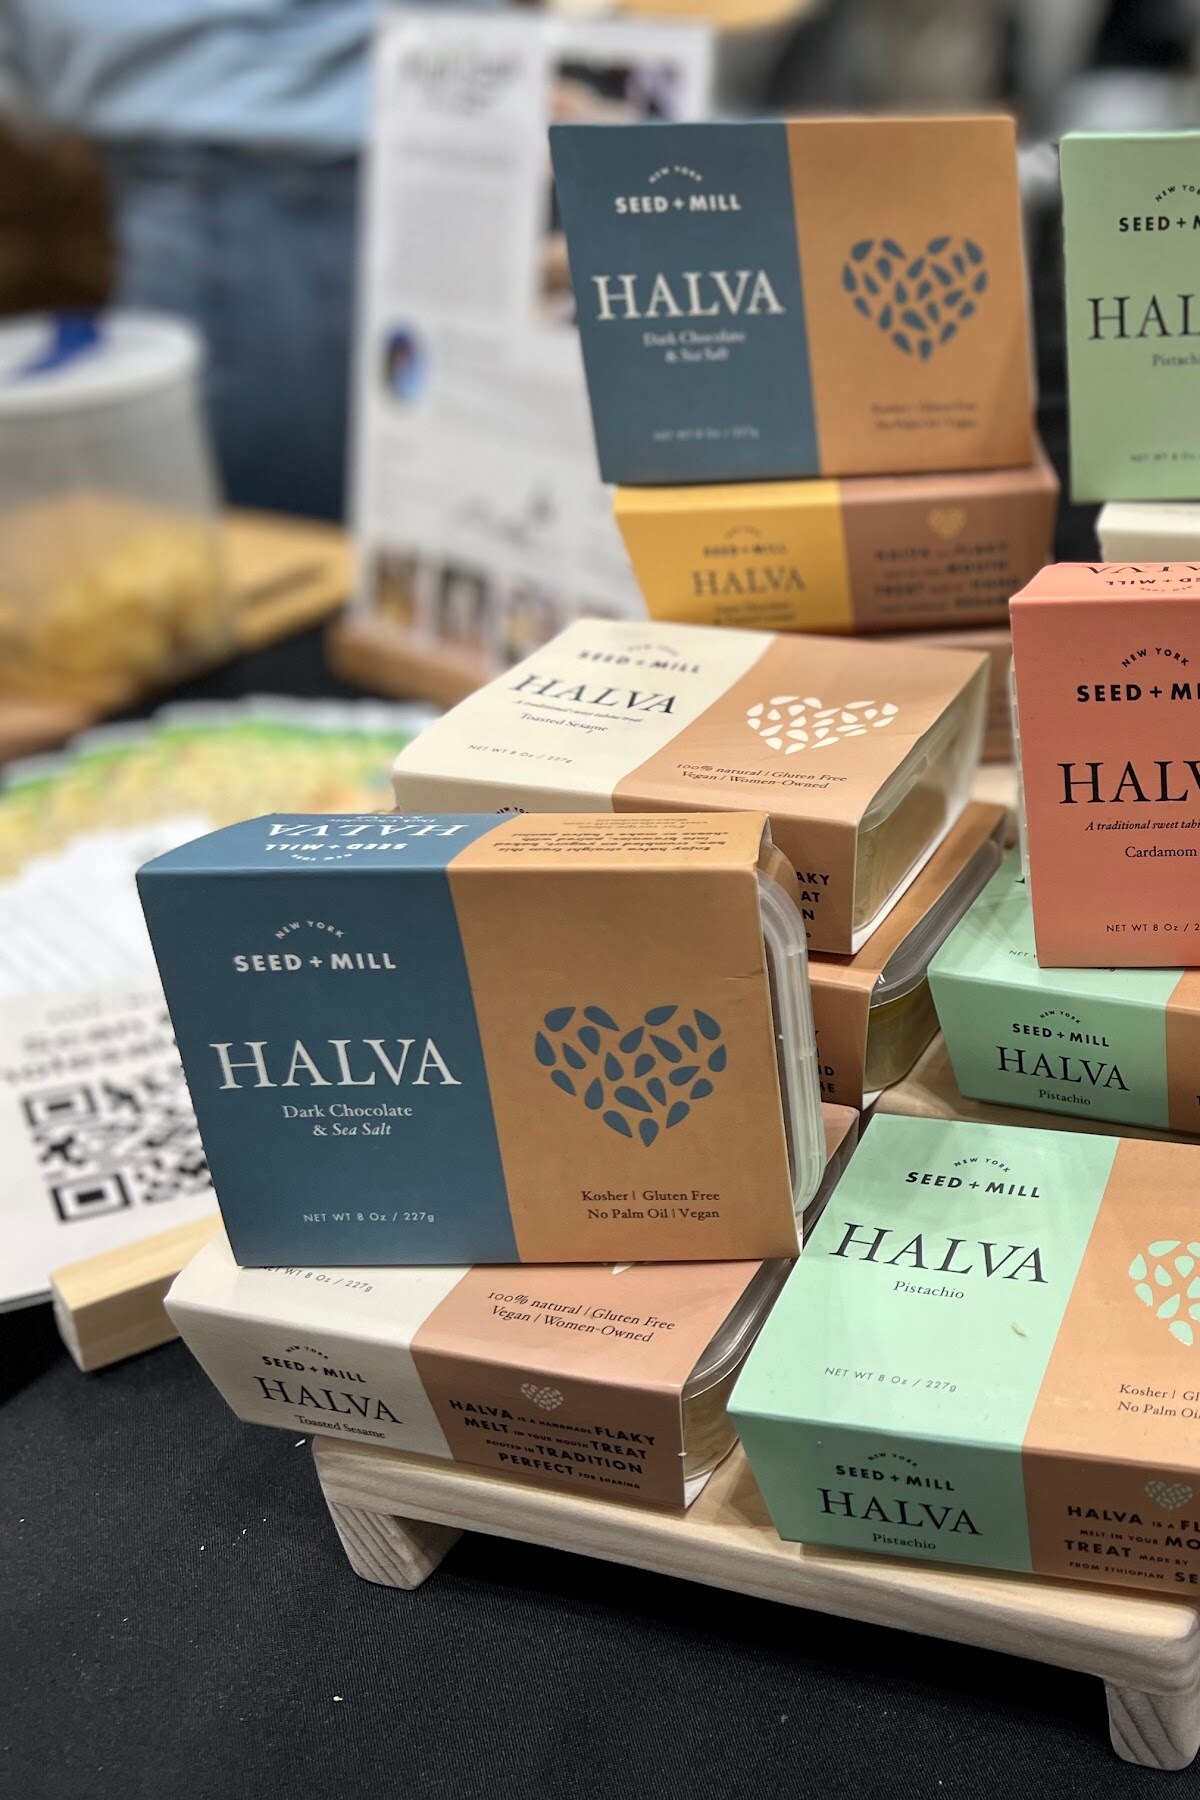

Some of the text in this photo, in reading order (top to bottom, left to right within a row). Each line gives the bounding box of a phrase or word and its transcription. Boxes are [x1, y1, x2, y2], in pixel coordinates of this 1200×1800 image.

[1155, 185, 1177, 202] NEW
[616, 195, 668, 214] SEED
[689, 194, 741, 212] MILL
[1119, 216, 1170, 232] SEED
[1177, 218, 1186, 228] +
[592, 270, 785, 321] HALVA
[643, 329, 746, 347] Dark Chocolate
[692, 567, 805, 596] HALVA
[577, 651, 630, 665] SEED
[650, 660, 701, 674] MILL
[1122, 647, 1189, 668] NEW YORK
[508, 674, 677, 714] HALVA
[1077, 684, 1142, 702] SEED
[1150, 686, 1162, 698] +
[520, 712, 608, 732] Toasted Sesame
[269, 824, 470, 836] HALVA
[1085, 819, 1094, 830] A
[1097, 818, 1150, 830] traditional
[1152, 820, 1179, 830] sweet
[1125, 846, 1197, 858] Cardamom
[275, 920, 344, 940] NEW YORK
[1106, 923, 1127, 932] NET
[1131, 923, 1147, 932] WT
[1153, 923, 1158, 931] 8
[1164, 923, 1179, 931] Oz
[234, 953, 396, 972] SEED + MILL
[1039, 1010, 1081, 1024] NEW YORK
[1012, 1023, 1052, 1038] SEED
[1070, 1032, 1110, 1047] MILL
[209, 1038, 462, 1089] HALVA
[996, 1046, 1130, 1091] HALVA
[1039, 1089, 1091, 1105] Pistachio
[283, 1104, 413, 1118] Dark Chocolate
[312, 1123, 391, 1136] & Sea Salt
[954, 1157, 1010, 1173] NEW YORK
[905, 1171, 1040, 1198] SEED + MILL
[581, 1190, 628, 1201] Kosher
[643, 1190, 688, 1201] Gluten
[692, 1190, 720, 1201] Free
[588, 1209, 608, 1219] No
[612, 1209, 644, 1219] Palm
[648, 1208, 668, 1218] Oil
[679, 1208, 720, 1220] Vegan
[829, 1222, 1049, 1284] HALVA
[893, 1280, 964, 1299] Pistachio
[262, 1356, 304, 1372] SEED
[323, 1367, 366, 1383] MILL
[253, 1376, 403, 1424] HALVA
[1119, 1384, 1168, 1399] Kosher
[1117, 1401, 1139, 1412] No
[1143, 1404, 1177, 1417] Palm
[294, 1414, 386, 1438] Toasted Sesame
[450, 1400, 514, 1421] HALVA
[539, 1420, 593, 1434] HANDMADE
[595, 1426, 656, 1445] FLAKY
[464, 1417, 510, 1434] MELT
[527, 1433, 552, 1442] YOUR
[555, 1439, 588, 1449] MOUTH
[590, 1440, 647, 1459] TREAT
[535, 1445, 642, 1474] TRADITION
[499, 1452, 640, 1489] PERFECT FOR SHARING
[836, 1465, 884, 1480] SEED
[906, 1476, 955, 1491] MILL
[817, 1487, 983, 1535] HALVA
[873, 1533, 936, 1550] Pistachio
